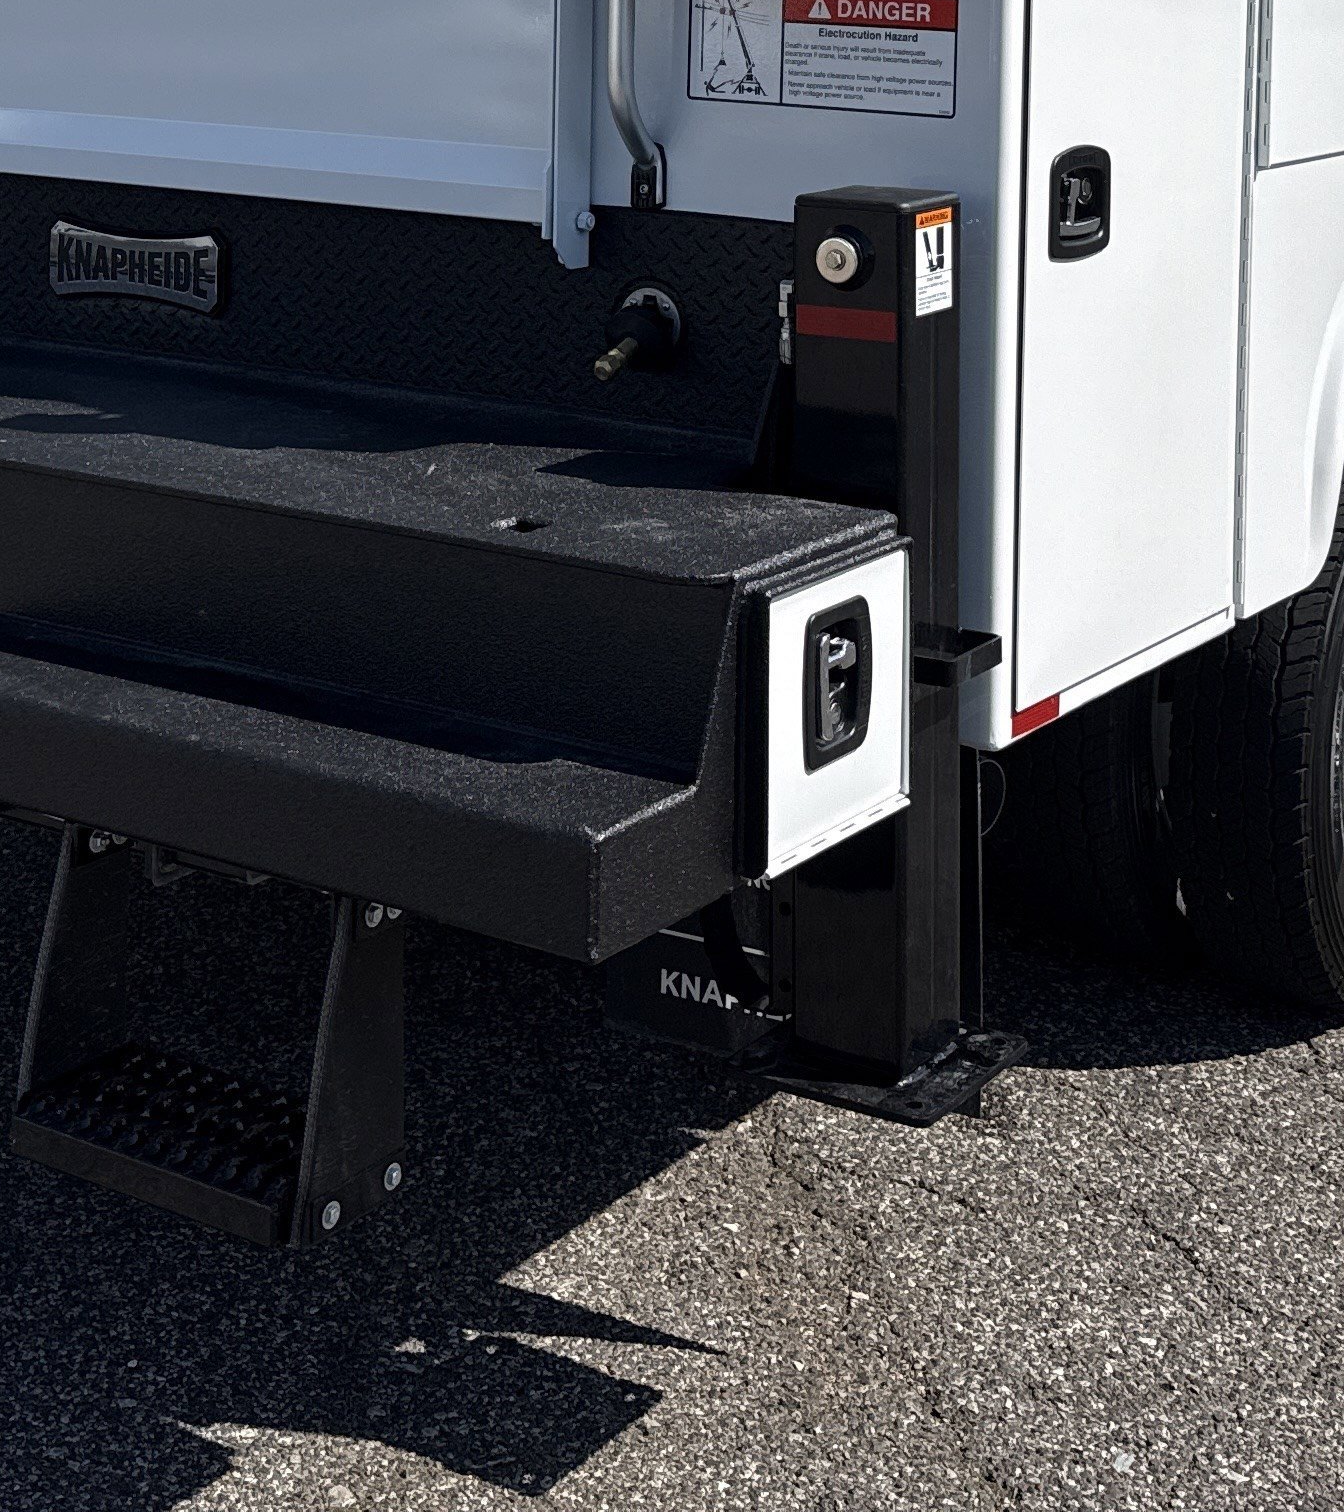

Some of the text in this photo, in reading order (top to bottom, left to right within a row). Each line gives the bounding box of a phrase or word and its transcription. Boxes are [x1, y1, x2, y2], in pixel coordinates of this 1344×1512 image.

[837, 0, 931, 23] DANGER
[818, 28, 919, 43] Electrocution Hazard
[57, 234, 209, 301] KNAPHEIDE
